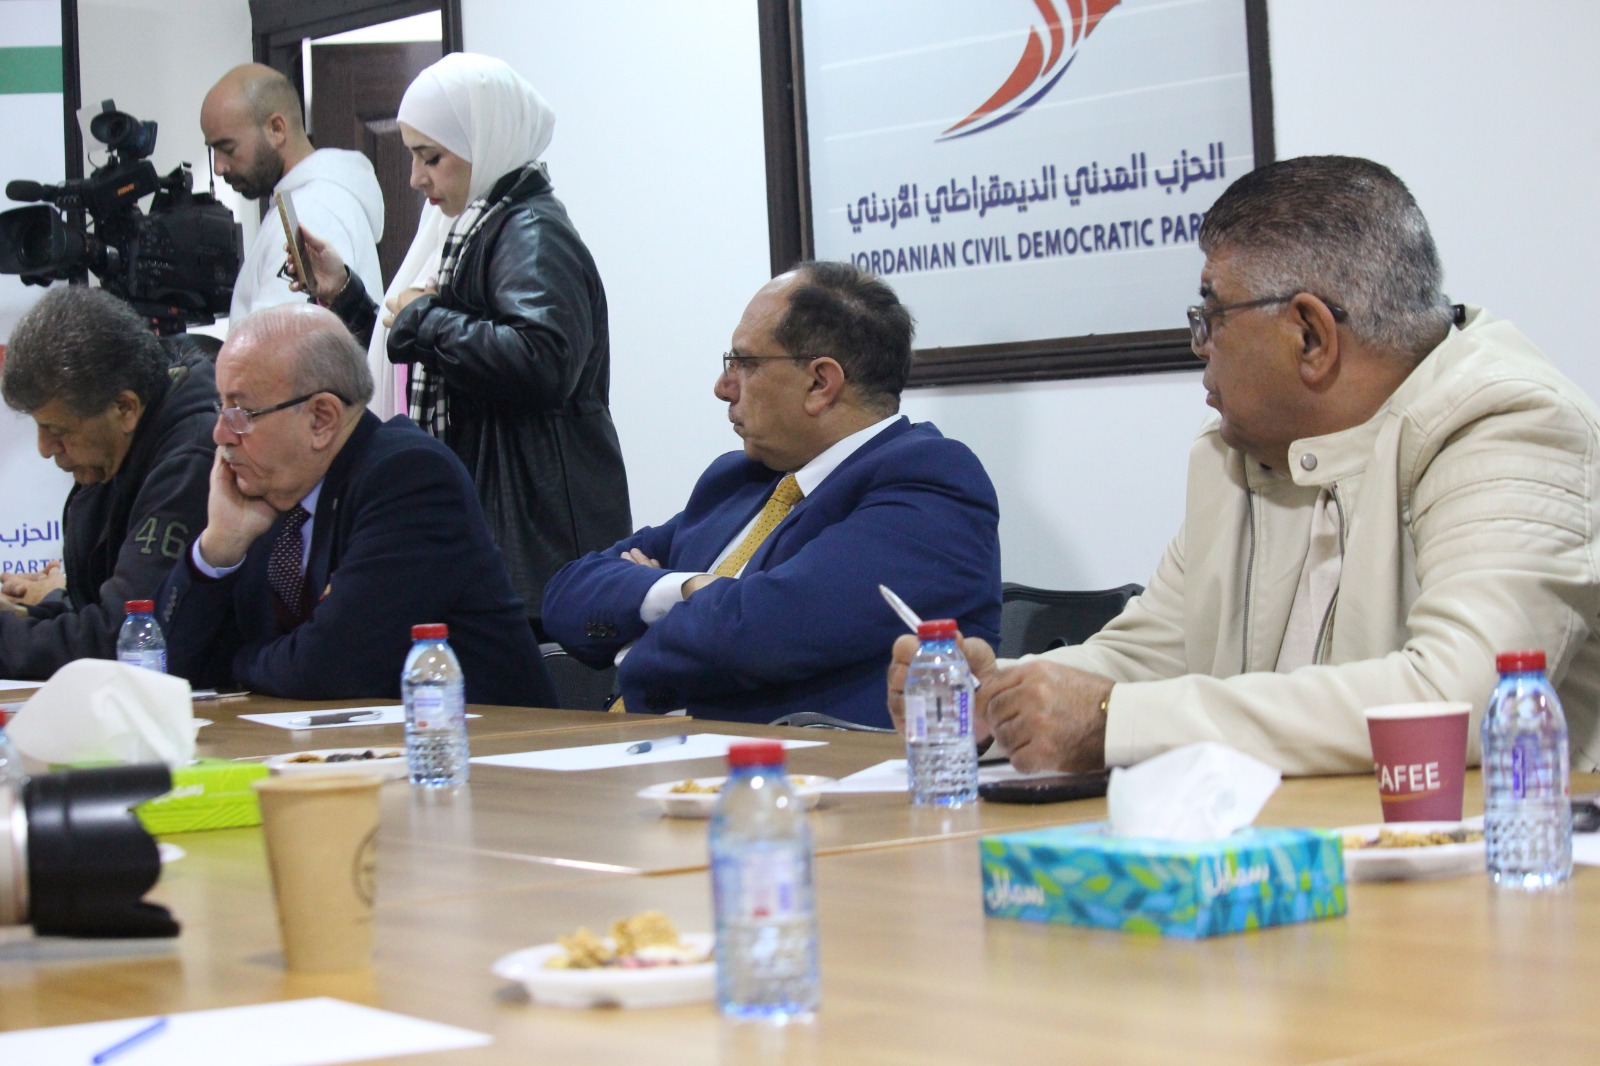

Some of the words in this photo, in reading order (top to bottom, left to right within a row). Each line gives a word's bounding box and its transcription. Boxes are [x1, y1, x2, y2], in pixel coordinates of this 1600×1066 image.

[1064, 151, 1147, 206] المدني
[1155, 141, 1225, 195] الحزب
[925, 164, 1057, 223] الديمقراطي
[962, 235, 1012, 265] CIVIL
[1018, 217, 1154, 260] DEMOCRATIC
[0, 520, 60, 548] الحزب
[135, 517, 189, 559] 46
[3, 559, 63, 574] PART
